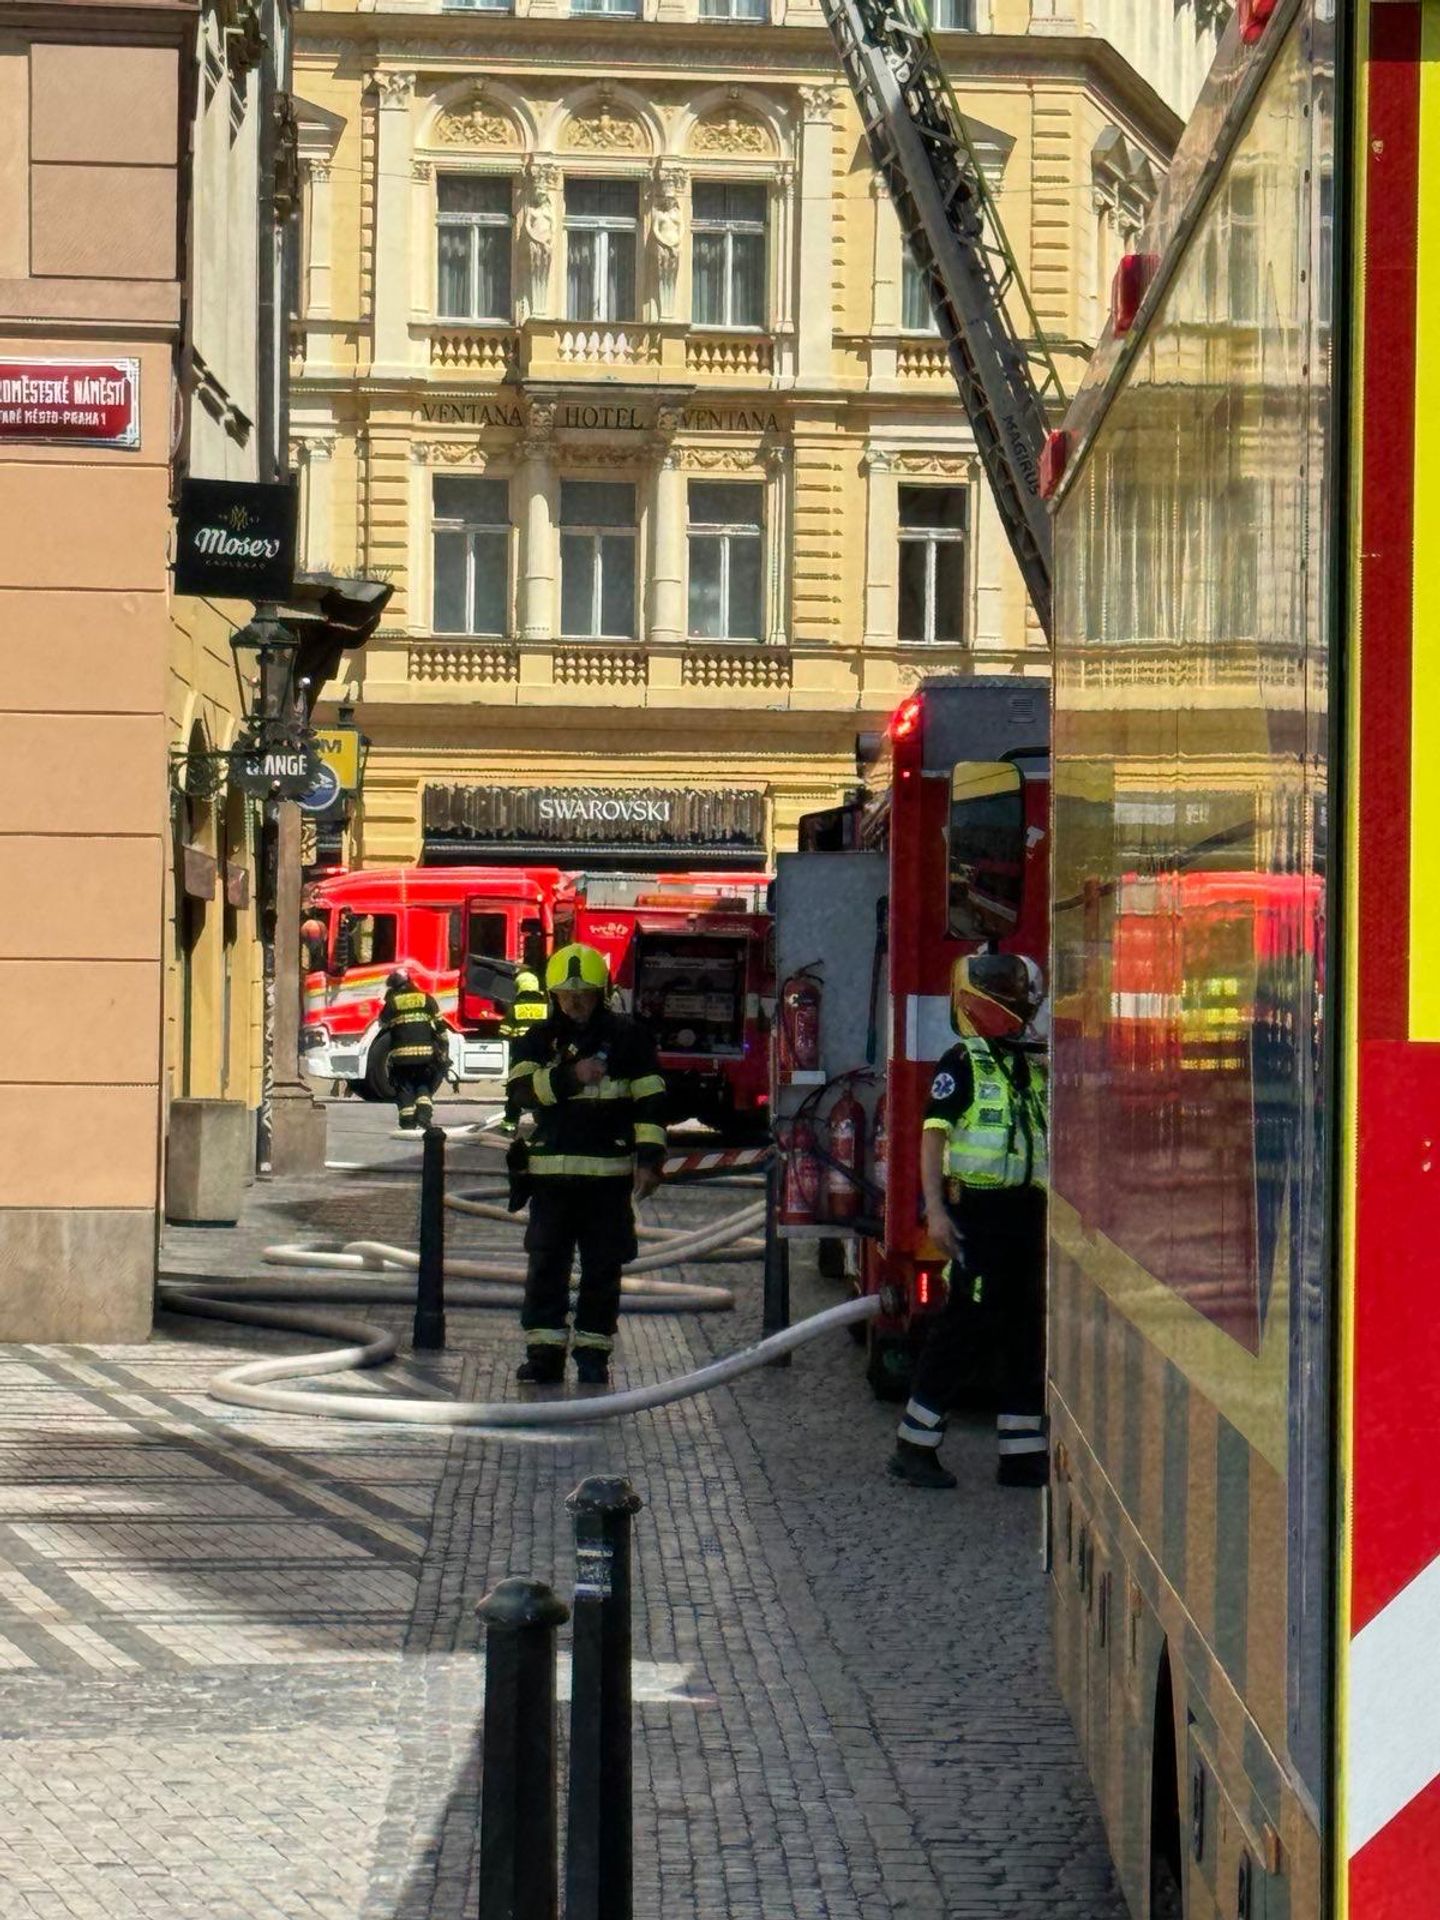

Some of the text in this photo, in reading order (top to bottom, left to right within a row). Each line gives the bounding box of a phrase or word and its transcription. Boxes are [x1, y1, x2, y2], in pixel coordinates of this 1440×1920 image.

[0, 375, 125, 406] OMĚSTSKÉ NÁMĚSTÍ
[101, 412, 107, 426] 1
[422, 403, 779, 432] VENTANA HOTEL VENTANA
[194, 528, 280, 559] Moser
[539, 799, 670, 822] SWAROVSKI
